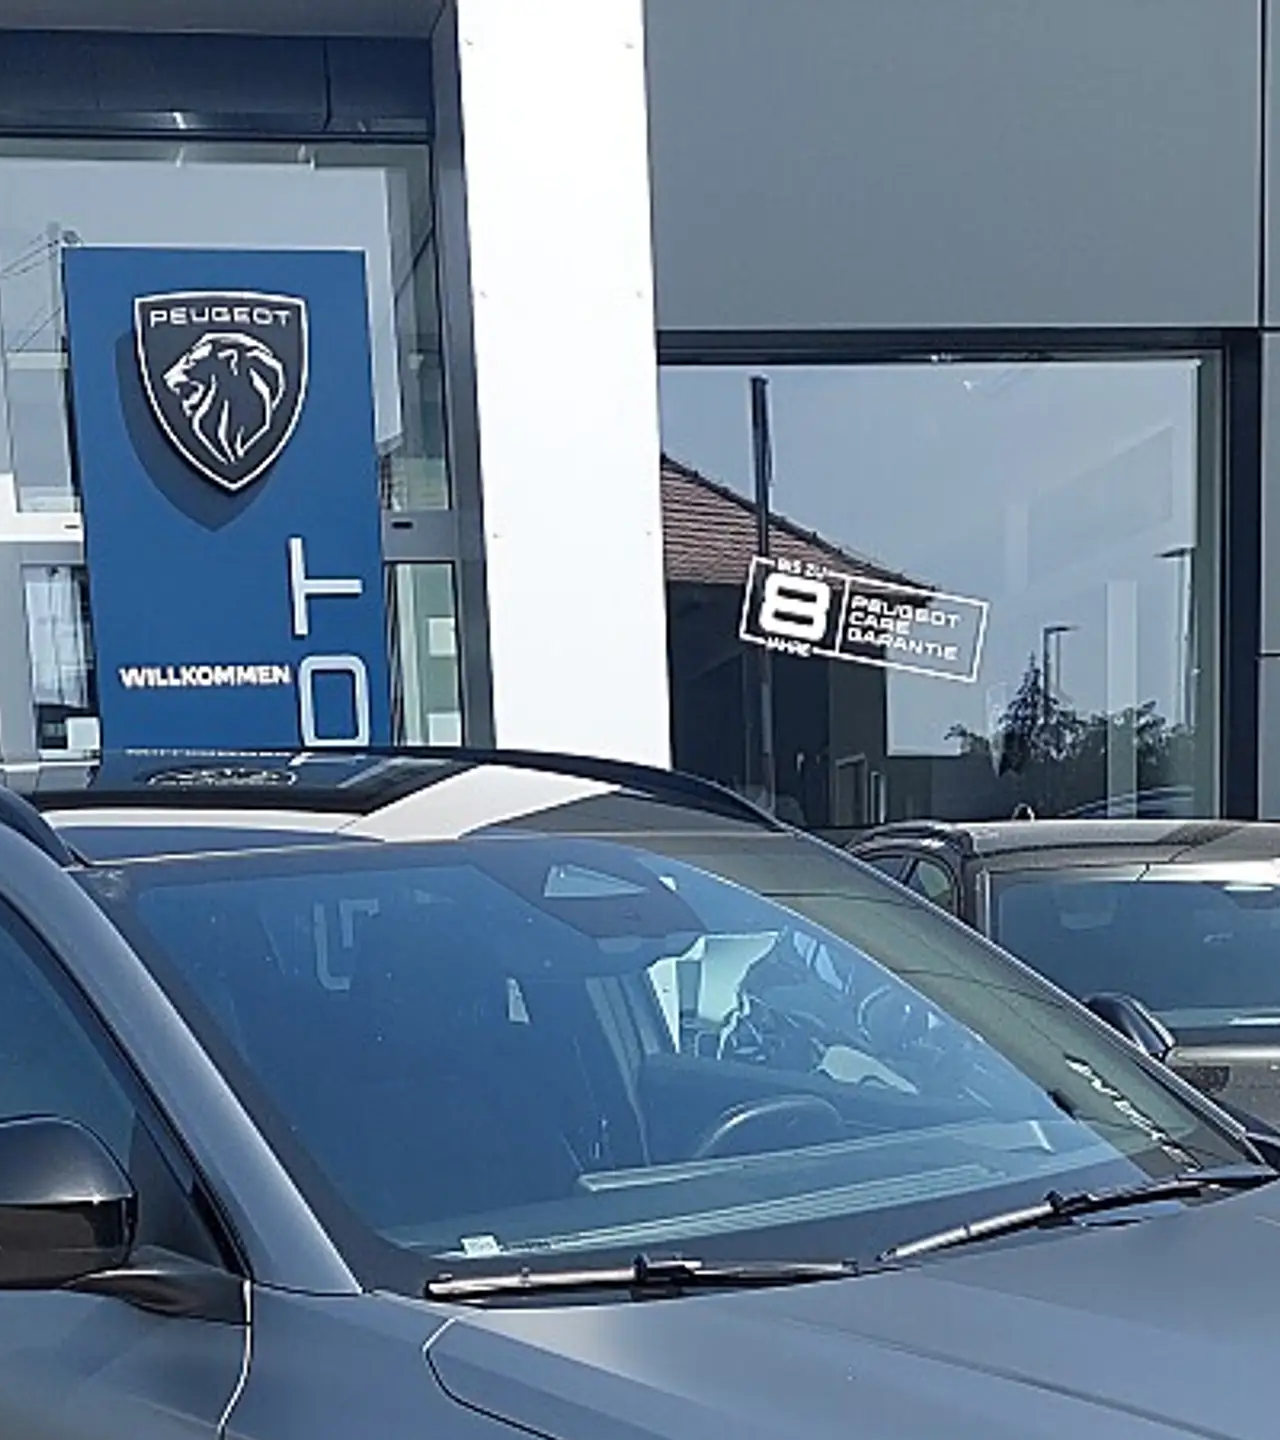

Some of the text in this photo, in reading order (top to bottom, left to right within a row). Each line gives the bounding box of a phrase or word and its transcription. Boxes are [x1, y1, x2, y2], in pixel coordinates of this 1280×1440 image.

[150, 307, 291, 328] PEUGEOT
[758, 571, 832, 642] 8
[851, 595, 961, 629] PEUGEOT
[848, 612, 911, 635] CARE
[846, 627, 960, 661] GARANTIE
[118, 664, 292, 688] WILLKOMMEN
